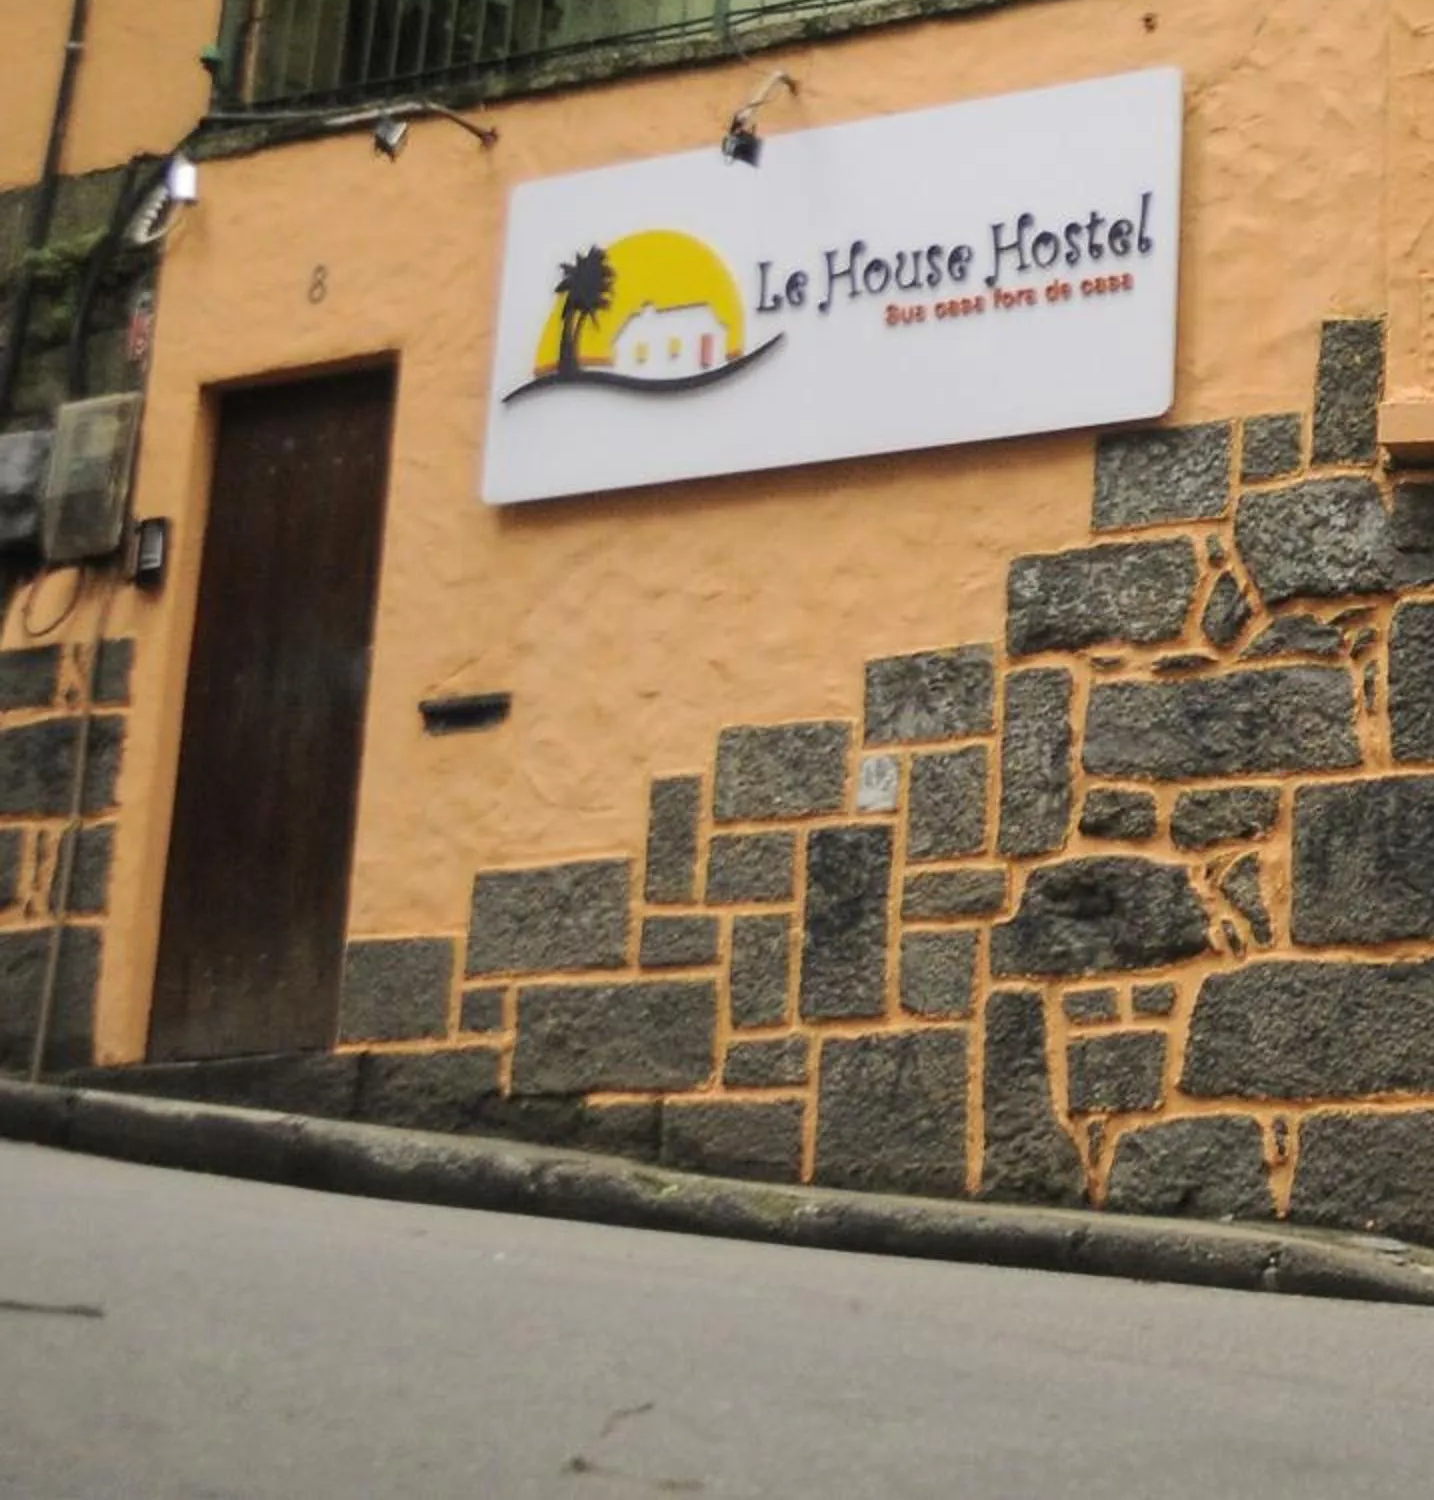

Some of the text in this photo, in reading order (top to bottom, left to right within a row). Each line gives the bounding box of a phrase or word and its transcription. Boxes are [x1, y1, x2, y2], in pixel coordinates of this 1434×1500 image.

[757, 191, 1153, 315] Le House Hostel
[307, 264, 328, 304] 8
[885, 273, 1135, 328] Sua casa fora de casa
